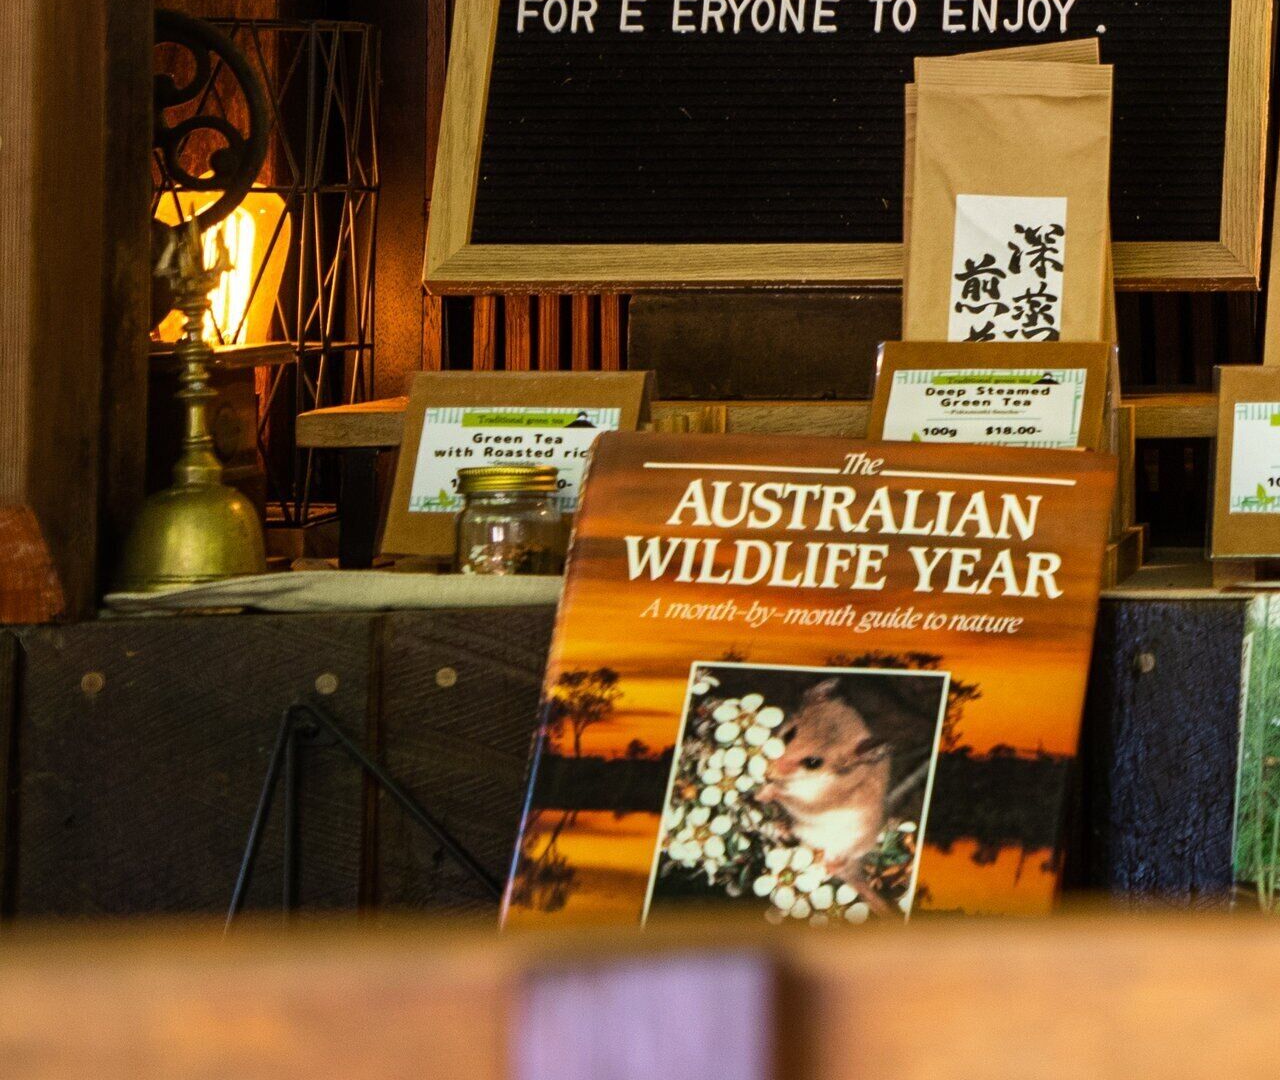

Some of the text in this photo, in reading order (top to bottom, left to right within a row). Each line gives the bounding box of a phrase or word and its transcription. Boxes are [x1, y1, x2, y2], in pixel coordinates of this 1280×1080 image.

[925, 387, 1051, 397] Deep Steamed
[941, 398, 1032, 407] Green Tea
[922, 427, 957, 437] 100g
[472, 433, 563, 444] Green Tea
[435, 447, 588, 458] with Roasted ric
[839, 452, 885, 478] The
[666, 478, 1043, 542] AUSTRALIAN
[623, 536, 1066, 600] WILDLIFE YEAR
[640, 598, 1024, 635] A month-by-month guide to nature
